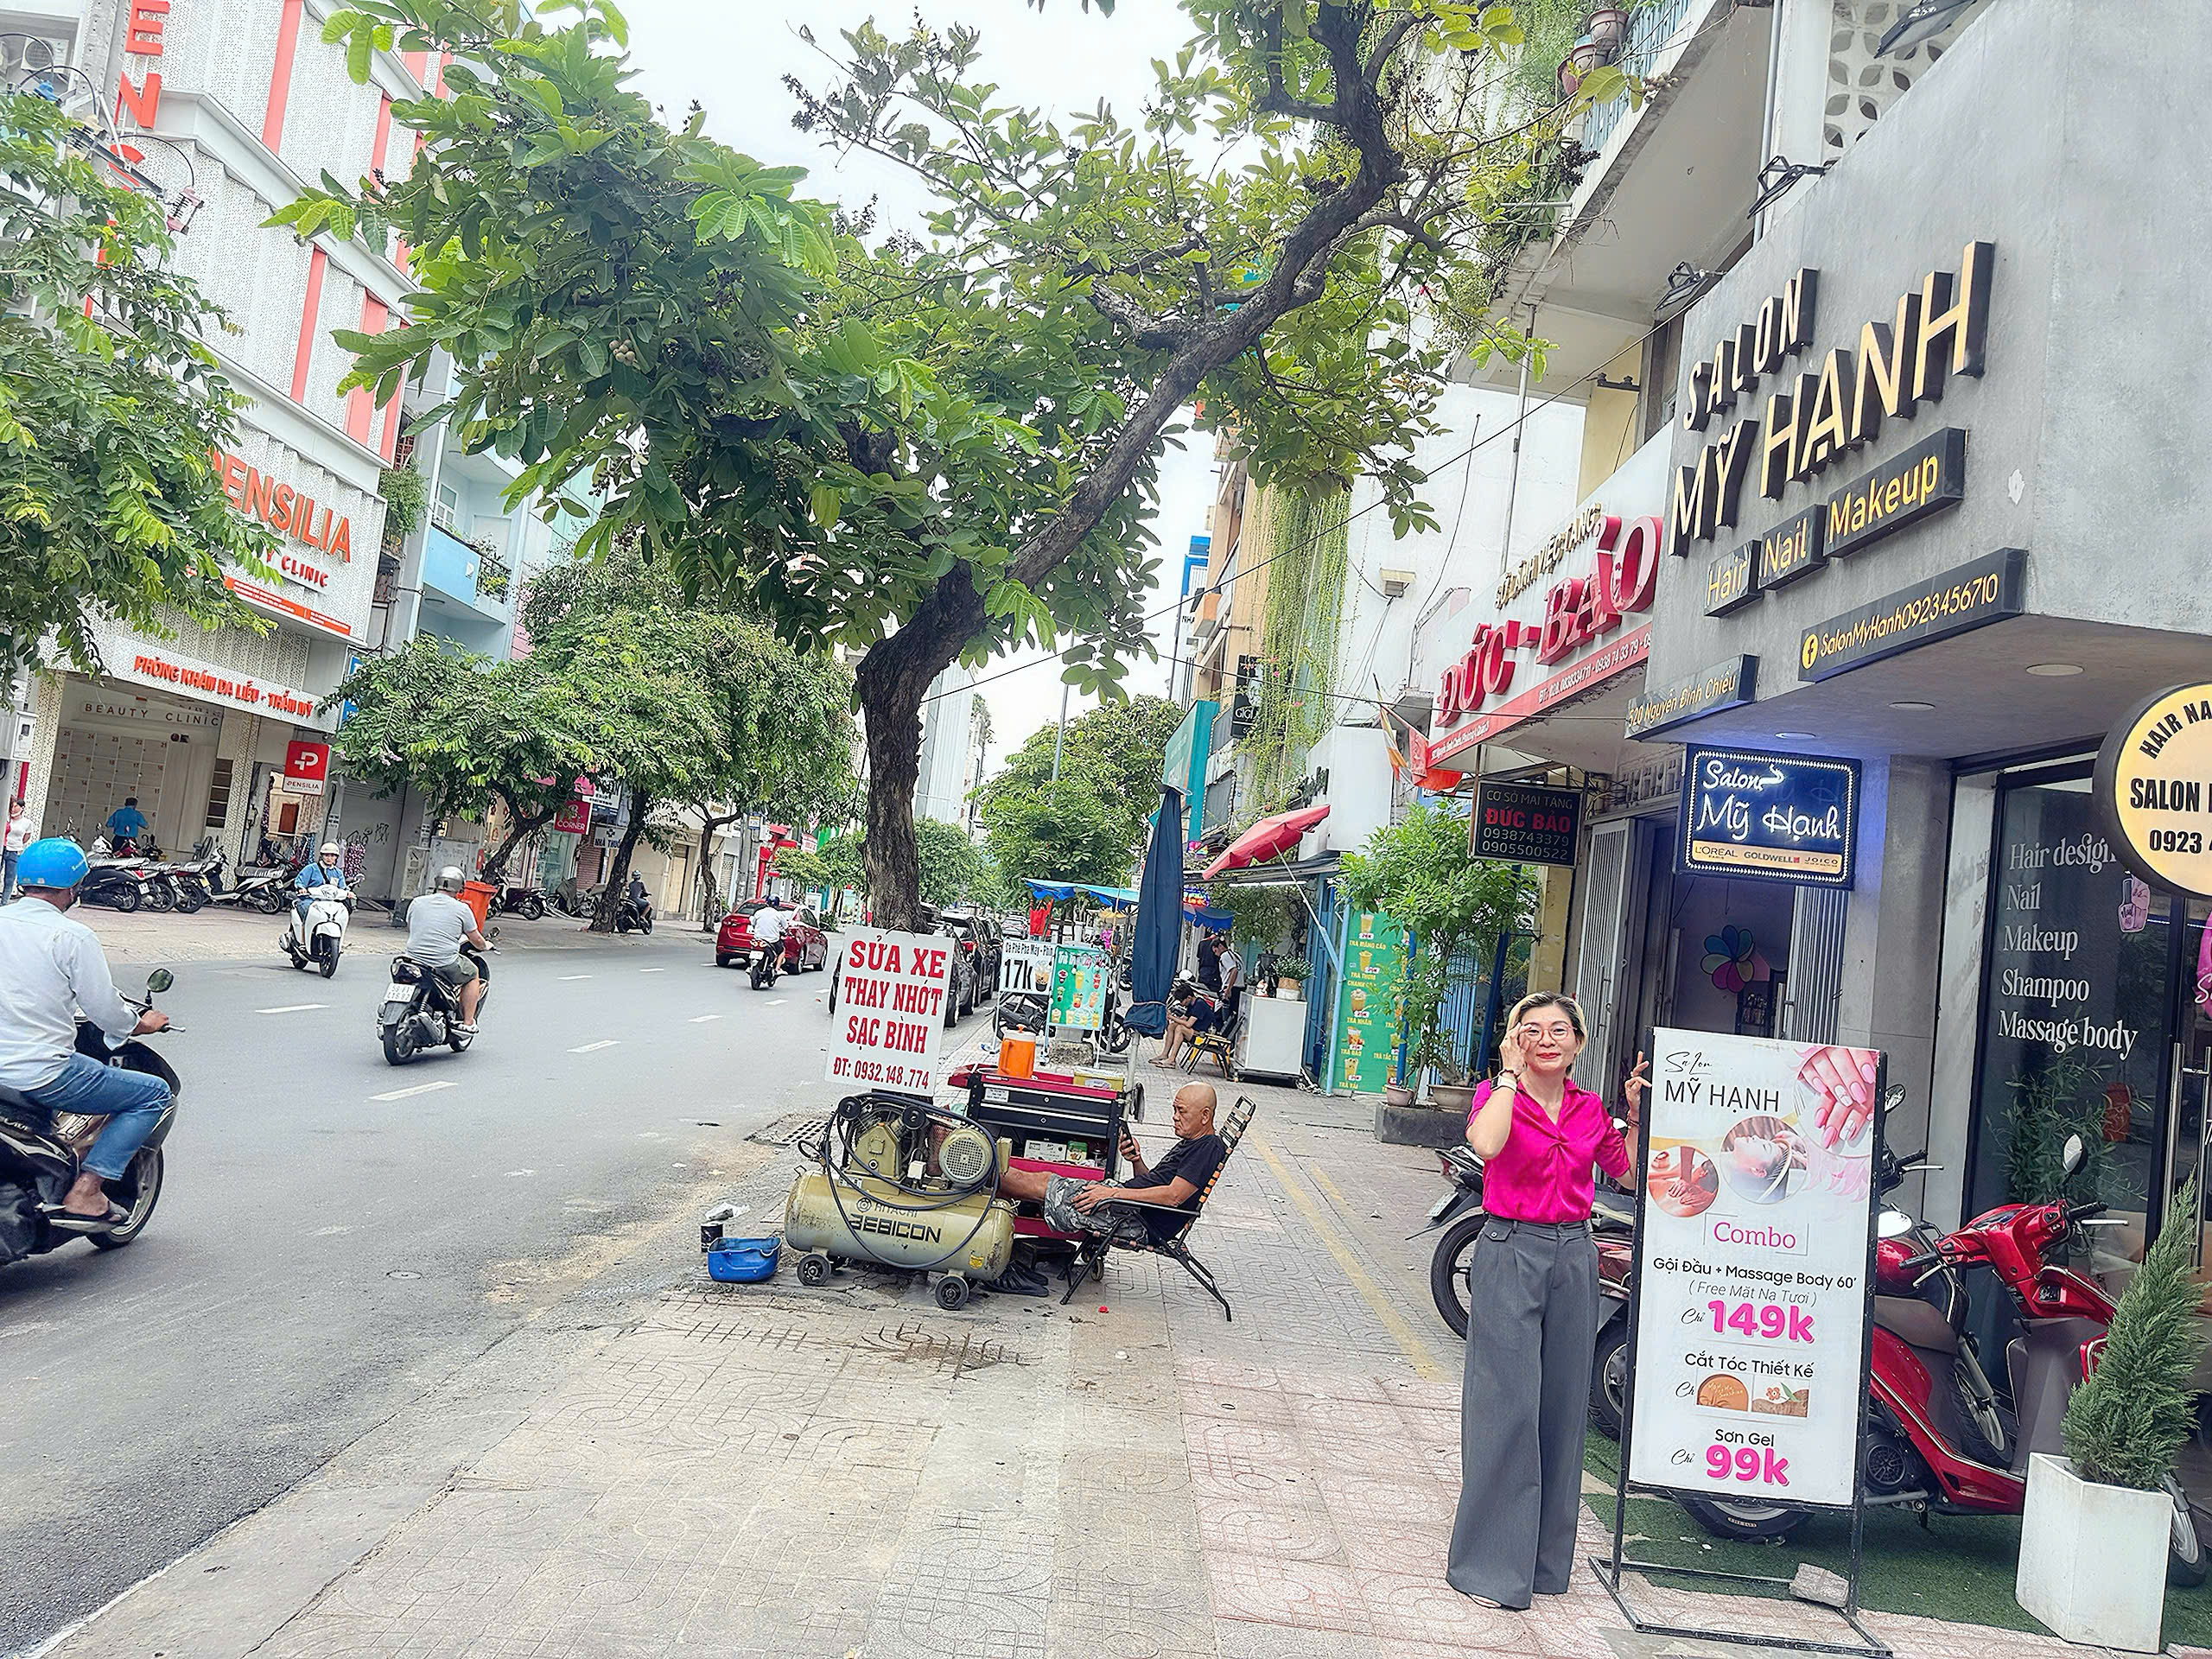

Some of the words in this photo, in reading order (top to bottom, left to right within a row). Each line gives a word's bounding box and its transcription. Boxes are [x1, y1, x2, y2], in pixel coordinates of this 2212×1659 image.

[1683, 268, 1818, 430] SALON
[1668, 419, 1759, 557] MỸ
[1759, 240, 1994, 499] HẠNH
[1707, 558, 1747, 606] Hair
[1763, 517, 1808, 578] Nail
[1827, 453, 1939, 545] Makeup
[281, 556, 329, 588] CLINIC
[1820, 573, 1999, 658] SalonMyHanh0923456710
[85, 703, 149, 718] BEAUTY
[165, 712, 219, 726] CLINIC
[1628, 704, 1643, 727] 520
[2139, 713, 2183, 760] HAIR
[1702, 760, 1780, 791] Salon
[1486, 789, 1502, 802] CƠ
[1503, 790, 1519, 803] SỞ
[1520, 793, 1541, 805] MAI
[2130, 778, 2200, 812] SALON
[556, 820, 585, 830] CORNER
[1485, 805, 1526, 828] ĐỨC
[1532, 810, 1571, 833] BẢO
[1695, 792, 1750, 841] Mỹ
[1762, 804, 1841, 842] Hạnh
[1482, 840, 1568, 861] 0905500522
[1483, 827, 1569, 847] 0938743379
[2149, 830, 2202, 855] 0923
[1744, 850, 1793, 863] GOLDWELL
[1804, 855, 1839, 865] JOICO
[2008, 842, 2050, 871] Hair
[2005, 880, 2041, 912] Nail
[849, 935, 901, 973] SỬA
[911, 947, 947, 979] XE
[2003, 925, 2078, 961] Makeup
[845, 976, 890, 1009] THAY
[893, 980, 944, 1016] NHỚT
[2001, 968, 2090, 1008] Shampoo
[846, 1015, 880, 1051] SẠC
[883, 1015, 929, 1054] BÌNH
[1997, 1009, 2079, 1054] Massage
[2082, 1019, 2139, 1062] body
[833, 1057, 852, 1077] ĐT:
[854, 1060, 930, 1090] 0932.148.774
[1665, 1077, 1701, 1104] MỸ
[1709, 1084, 1779, 1113] HẠNH
[1713, 1221, 1796, 1249] Combo
[1652, 1257, 1678, 1277] Gội
[1681, 1257, 1712, 1275] Đầu
[1726, 1265, 1793, 1286] Massage
[1796, 1273, 1834, 1291] Body
[1729, 1283, 1756, 1300] Mặt
[1758, 1287, 1777, 1303] Nạ
[1707, 1300, 1816, 1344] 149k
[1684, 1350, 1714, 1369] Cắt
[1718, 1354, 1748, 1372] Tóc
[1751, 1358, 1791, 1376] Thiết
[1793, 1360, 1815, 1379] Kế
[1675, 1381, 1694, 1398] Ch
[1714, 1428, 1744, 1445] Sơn
[1748, 1432, 1775, 1447] Gel
[1705, 1444, 1790, 1486] 99k
